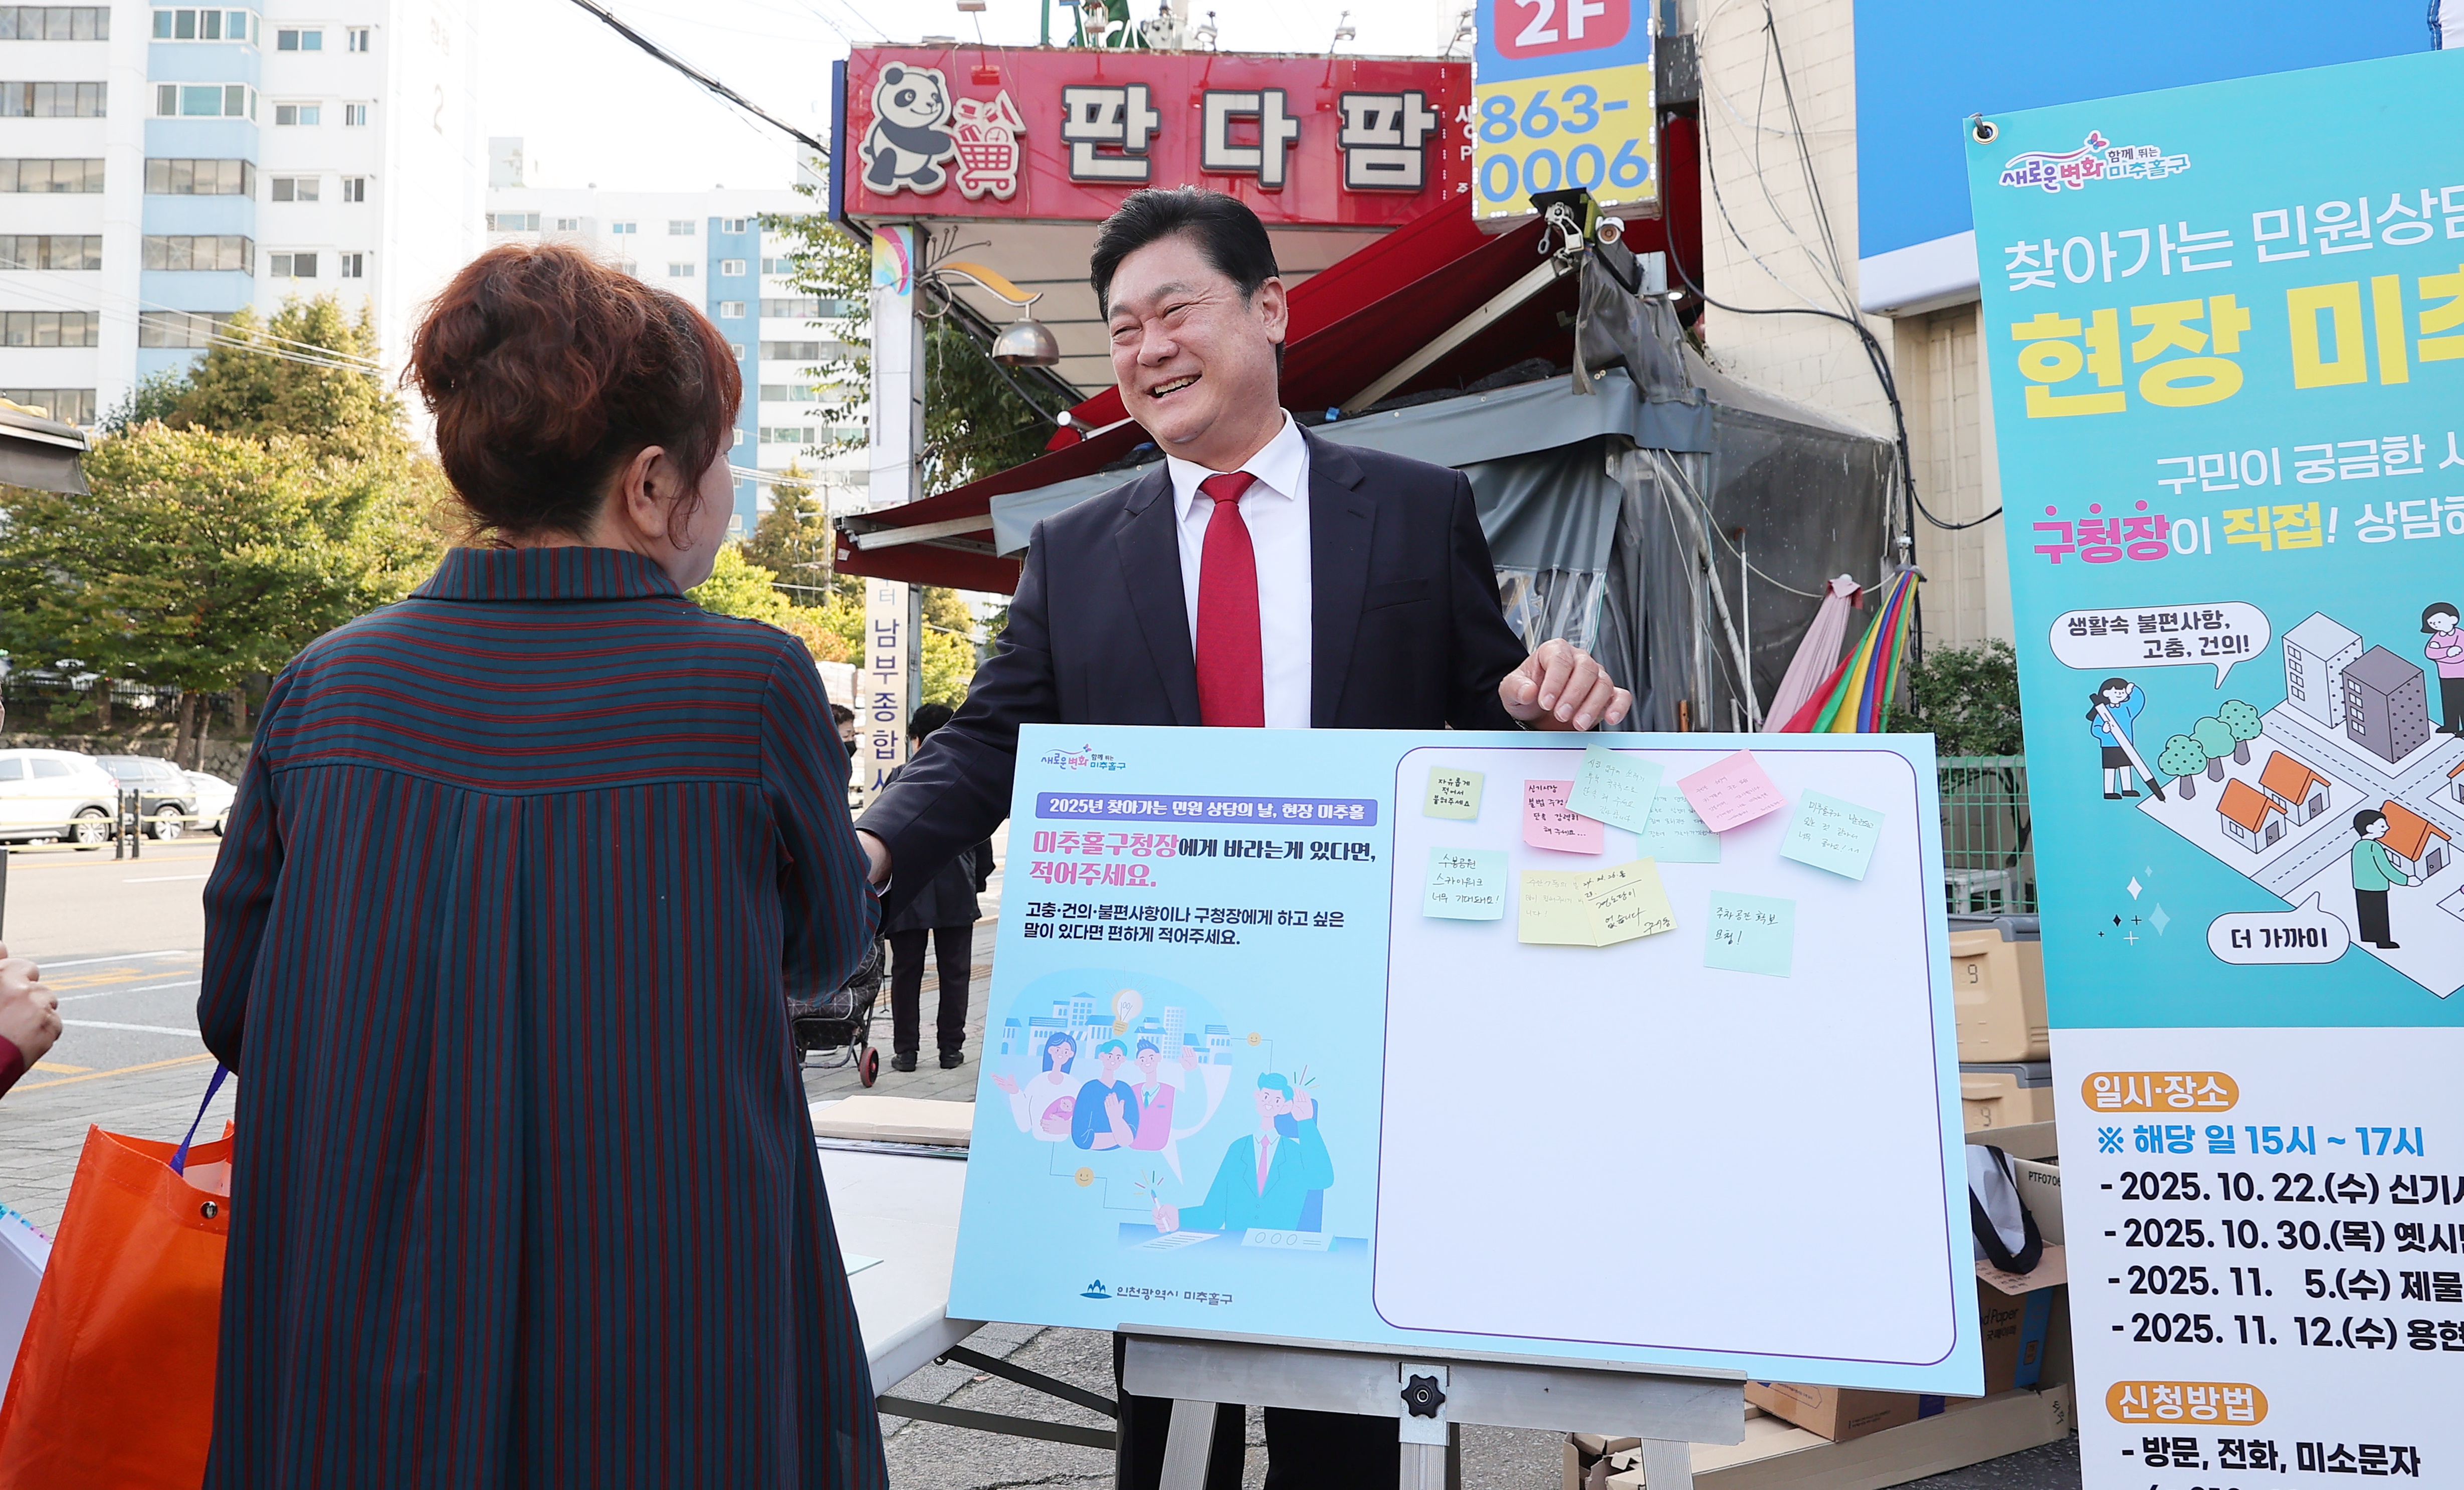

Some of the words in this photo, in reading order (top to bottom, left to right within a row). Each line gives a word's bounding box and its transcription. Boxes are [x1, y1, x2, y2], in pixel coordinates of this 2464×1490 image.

[1515, 0, 1604, 47] 2F
[1479, 84, 1628, 143] 863-
[1060, 82, 1439, 193] 판다팜
[2107, 147, 2134, 163] 함께
[2138, 147, 2158, 159] 뛰는
[2109, 157, 2187, 178] 미추홀구
[1480, 139, 1649, 202] 0006
[2002, 160, 2058, 190] 새로운
[2061, 157, 2104, 188] 변화
[2004, 221, 2234, 292] 찾아가는
[2011, 294, 2251, 418] 현장
[2157, 447, 2282, 495] 구민이
[2293, 433, 2426, 484] 궁금한
[2033, 514, 2213, 564] 구청장이
[2222, 501, 2339, 552] 직접!
[2068, 615, 2130, 636] 생활속
[2137, 609, 2230, 634] 불편사항,
[2143, 637, 2192, 659] 고충,
[2198, 634, 2250, 657] 건의!
[1041, 753, 1067, 770] 새로운
[1068, 755, 1089, 770] 변화
[1090, 762, 1126, 771] 미추홀구
[1438, 777, 1471, 787] 자유롭게
[1442, 787, 1464, 796] 적어서
[1049, 798, 1103, 814] 2025년
[1107, 799, 1168, 815] 찾아가는
[1172, 800, 1203, 816] 민원
[1206, 801, 1253, 817] 상담의
[1257, 802, 1277, 819] 날,
[1282, 803, 1314, 819] 현장
[1317, 803, 1365, 820] 미추홀
[1533, 812, 1547, 821] 단속
[1548, 798, 1568, 806] 주정
[1033, 830, 1218, 858] 미추홀구청장에게
[1223, 839, 1304, 860] 바라는게
[1310, 841, 1376, 863] 있다면,
[1029, 861, 1157, 888] 적어주세요.
[1438, 854, 1476, 870] 수봉공원
[1432, 892, 1449, 904] 너무
[1025, 902, 1191, 923] 고충·건의·불편사항이나
[1194, 907, 1273, 926] 구청장에게
[1278, 910, 1309, 926] 하고
[1313, 911, 1345, 928] 싶은
[1024, 922, 1054, 939] 말이
[1058, 923, 1104, 941] 있다면
[1108, 925, 1154, 942] 편하게
[1158, 927, 1241, 945] 적어주세요.
[2231, 928, 2251, 949] 더
[2260, 927, 2328, 949] 가까이
[2092, 1075, 2229, 1109] 일시·장소
[2133, 1124, 2196, 1154] 해당
[2205, 1124, 2236, 1155] 일
[2245, 1126, 2318, 1156] 15시
[2356, 1127, 2425, 1157] 17시
[2120, 1171, 2210, 1200] 2025.
[2217, 1172, 2264, 1202] 10.
[2272, 1172, 2380, 1204] 22.(수)
[2124, 1218, 2213, 1248] 2025.
[2221, 1219, 2268, 1249] 10.
[2277, 1219, 2385, 1253] 30.(목)
[2394, 1222, 2464, 1253] 옛시
[1116, 1286, 1178, 1301] 인천광역시
[1183, 1291, 1233, 1306] 미추홀구
[2128, 1265, 2219, 1295] 2025.
[2229, 1267, 2273, 1297] 11.
[2305, 1268, 2391, 1301] 5.(수)
[2132, 1313, 2223, 1343] 2025.
[2234, 1315, 2277, 1345] 11.
[2295, 1316, 2397, 1350] 12.(수)
[2120, 1385, 2255, 1422] 신청방법
[2142, 1436, 2209, 1470] 방문,
[2217, 1437, 2287, 1473] 전화,
[2296, 1441, 2420, 1477] 미소문자
